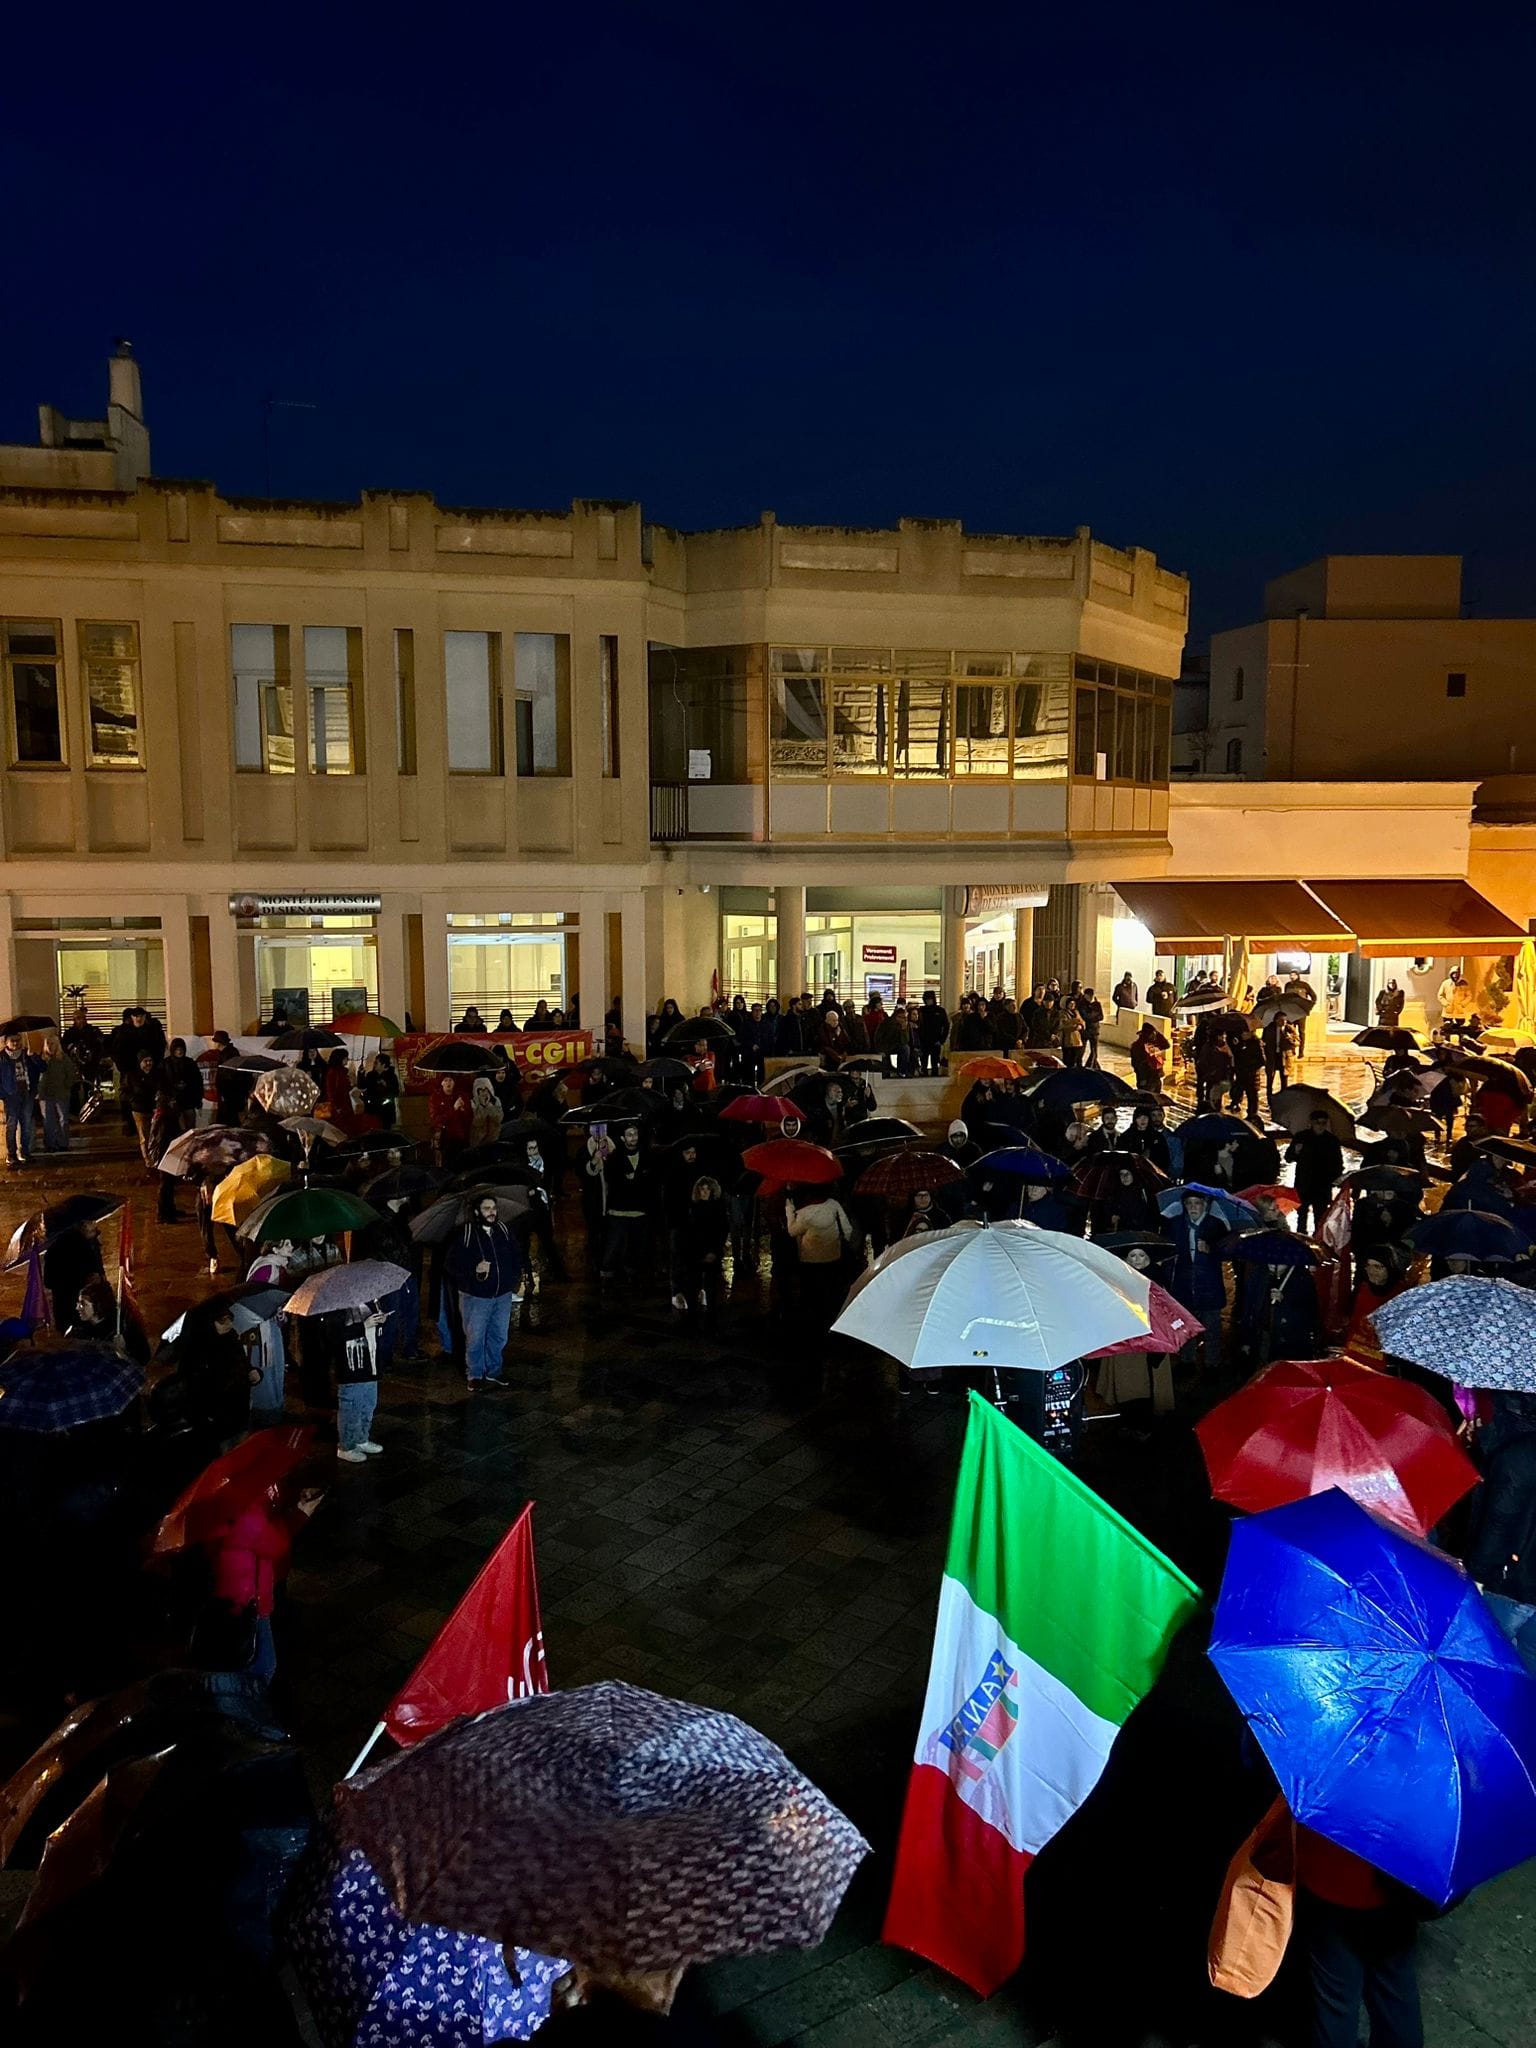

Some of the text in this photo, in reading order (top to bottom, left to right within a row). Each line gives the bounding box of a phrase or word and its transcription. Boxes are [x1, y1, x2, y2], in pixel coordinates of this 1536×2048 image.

[982, 884, 1010, 897] MONTE
[1011, 884, 1023, 894] DEI
[262, 895, 375, 905] MONTE DEI PASCHI
[263, 906, 275, 914] DI
[279, 906, 313, 915] SIENA
